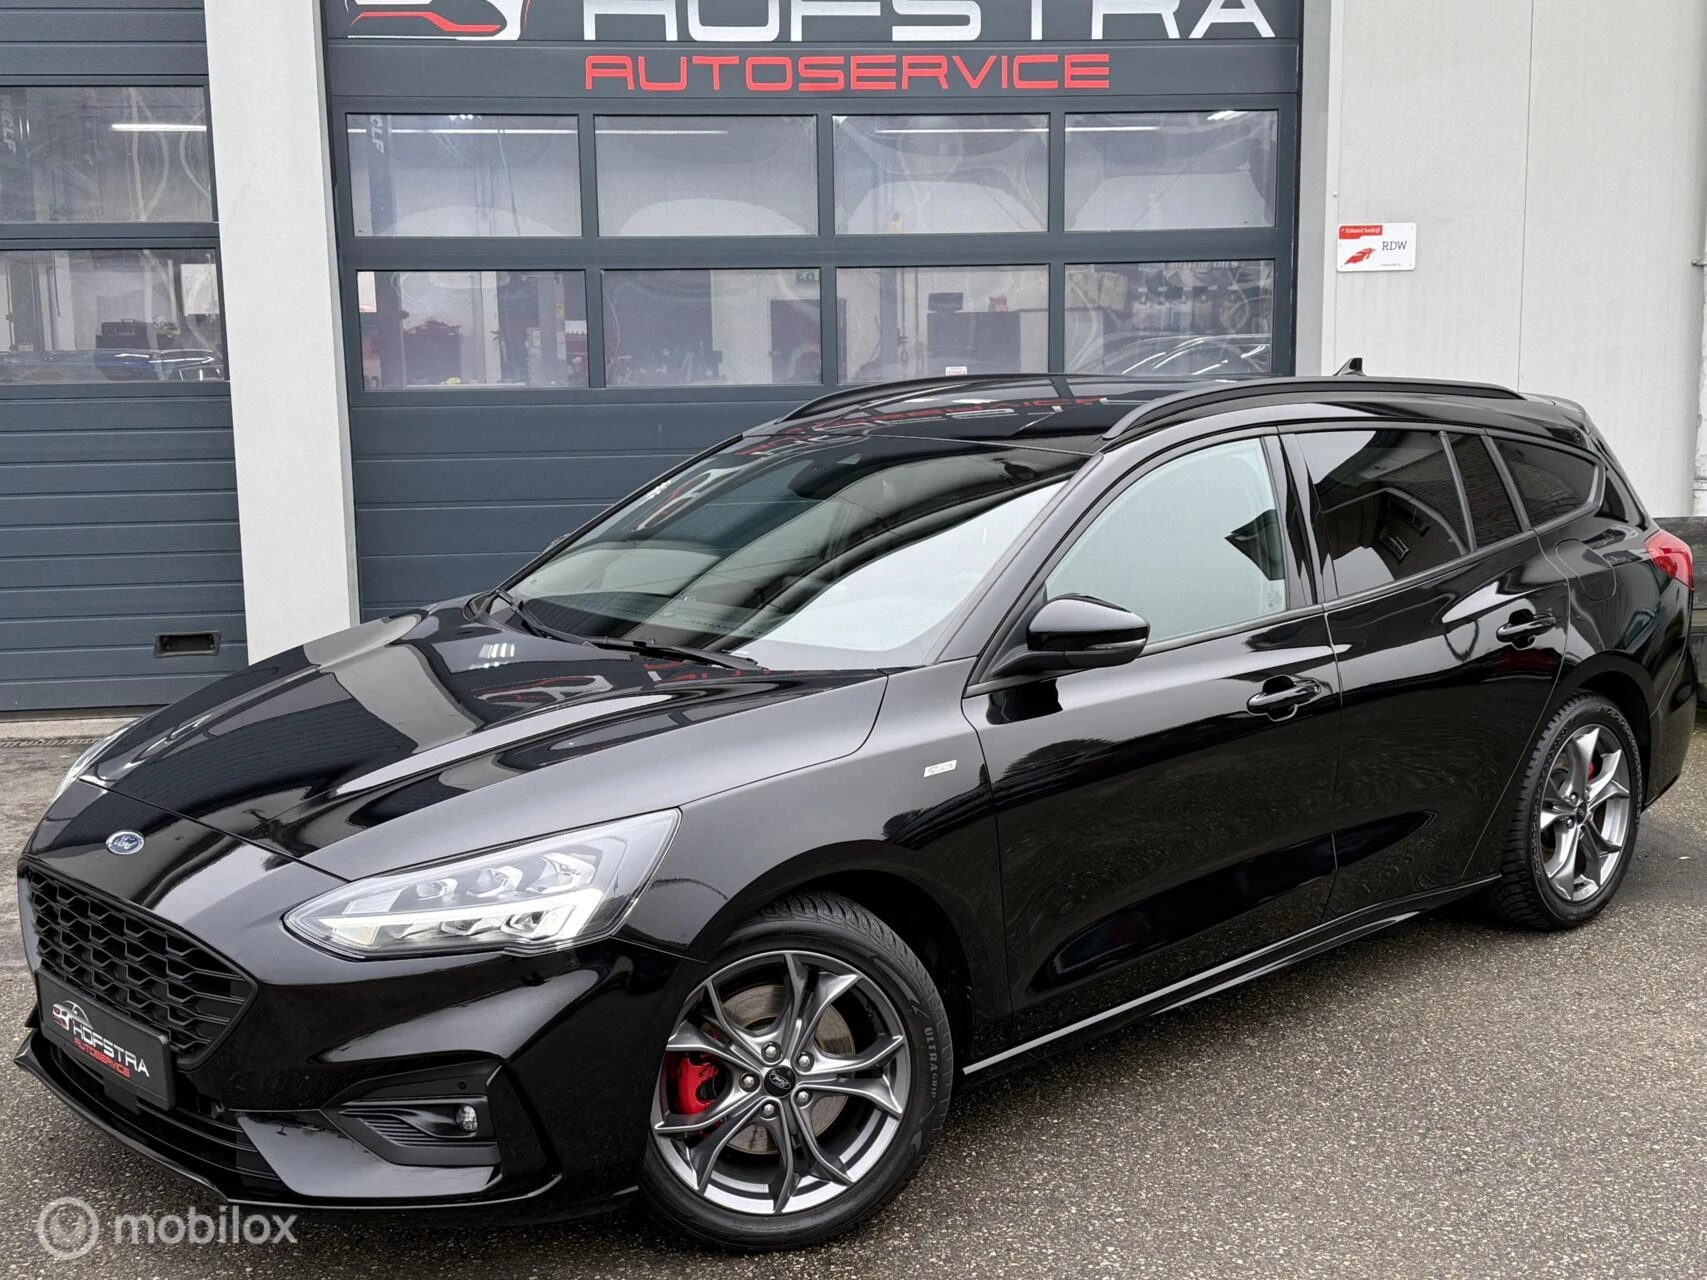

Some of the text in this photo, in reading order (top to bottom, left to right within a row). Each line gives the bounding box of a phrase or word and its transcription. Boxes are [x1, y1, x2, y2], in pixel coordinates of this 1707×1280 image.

[585, 54, 1109, 91] AUTOSERVICE
[1382, 241, 1407, 251] RDW
[113, 836, 138, 850] Ford
[72, 1019, 150, 1078] HOFSTRA
[73, 1037, 131, 1078] AUTOSERVICE
